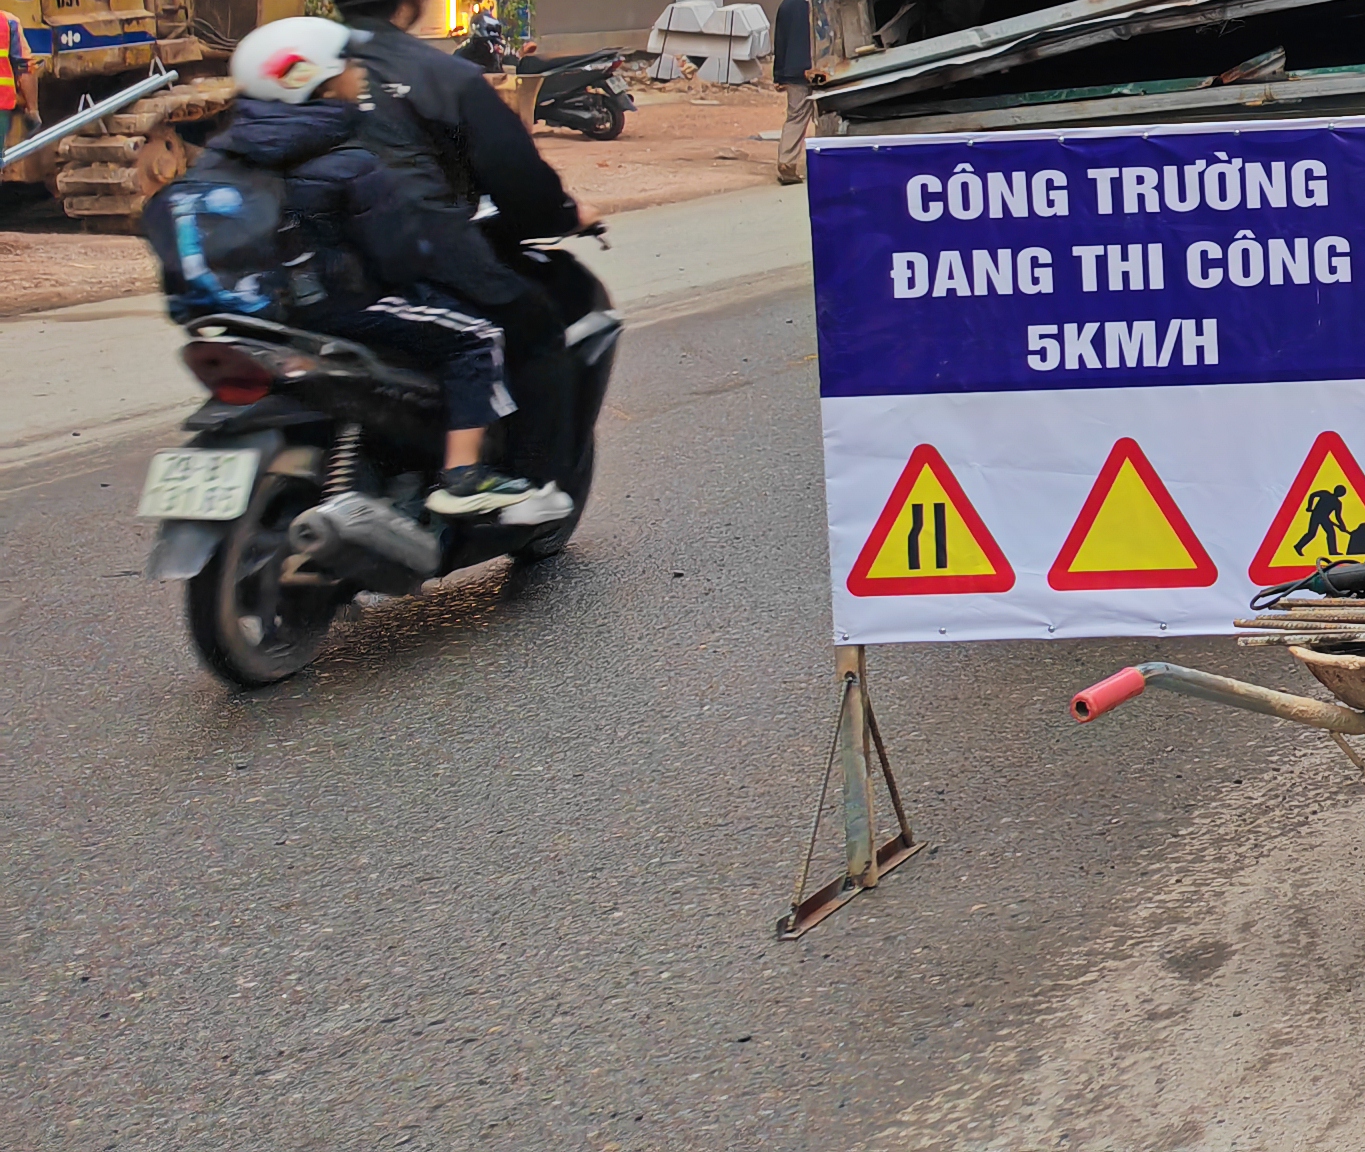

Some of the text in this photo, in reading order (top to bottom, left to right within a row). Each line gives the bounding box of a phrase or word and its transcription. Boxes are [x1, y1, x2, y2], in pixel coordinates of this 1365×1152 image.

[906, 151, 1329, 222] CÔNG TRƯỜNG
[890, 229, 1352, 299] ĐANG THI CÔNG
[1027, 318, 1219, 371] 5KM/H
